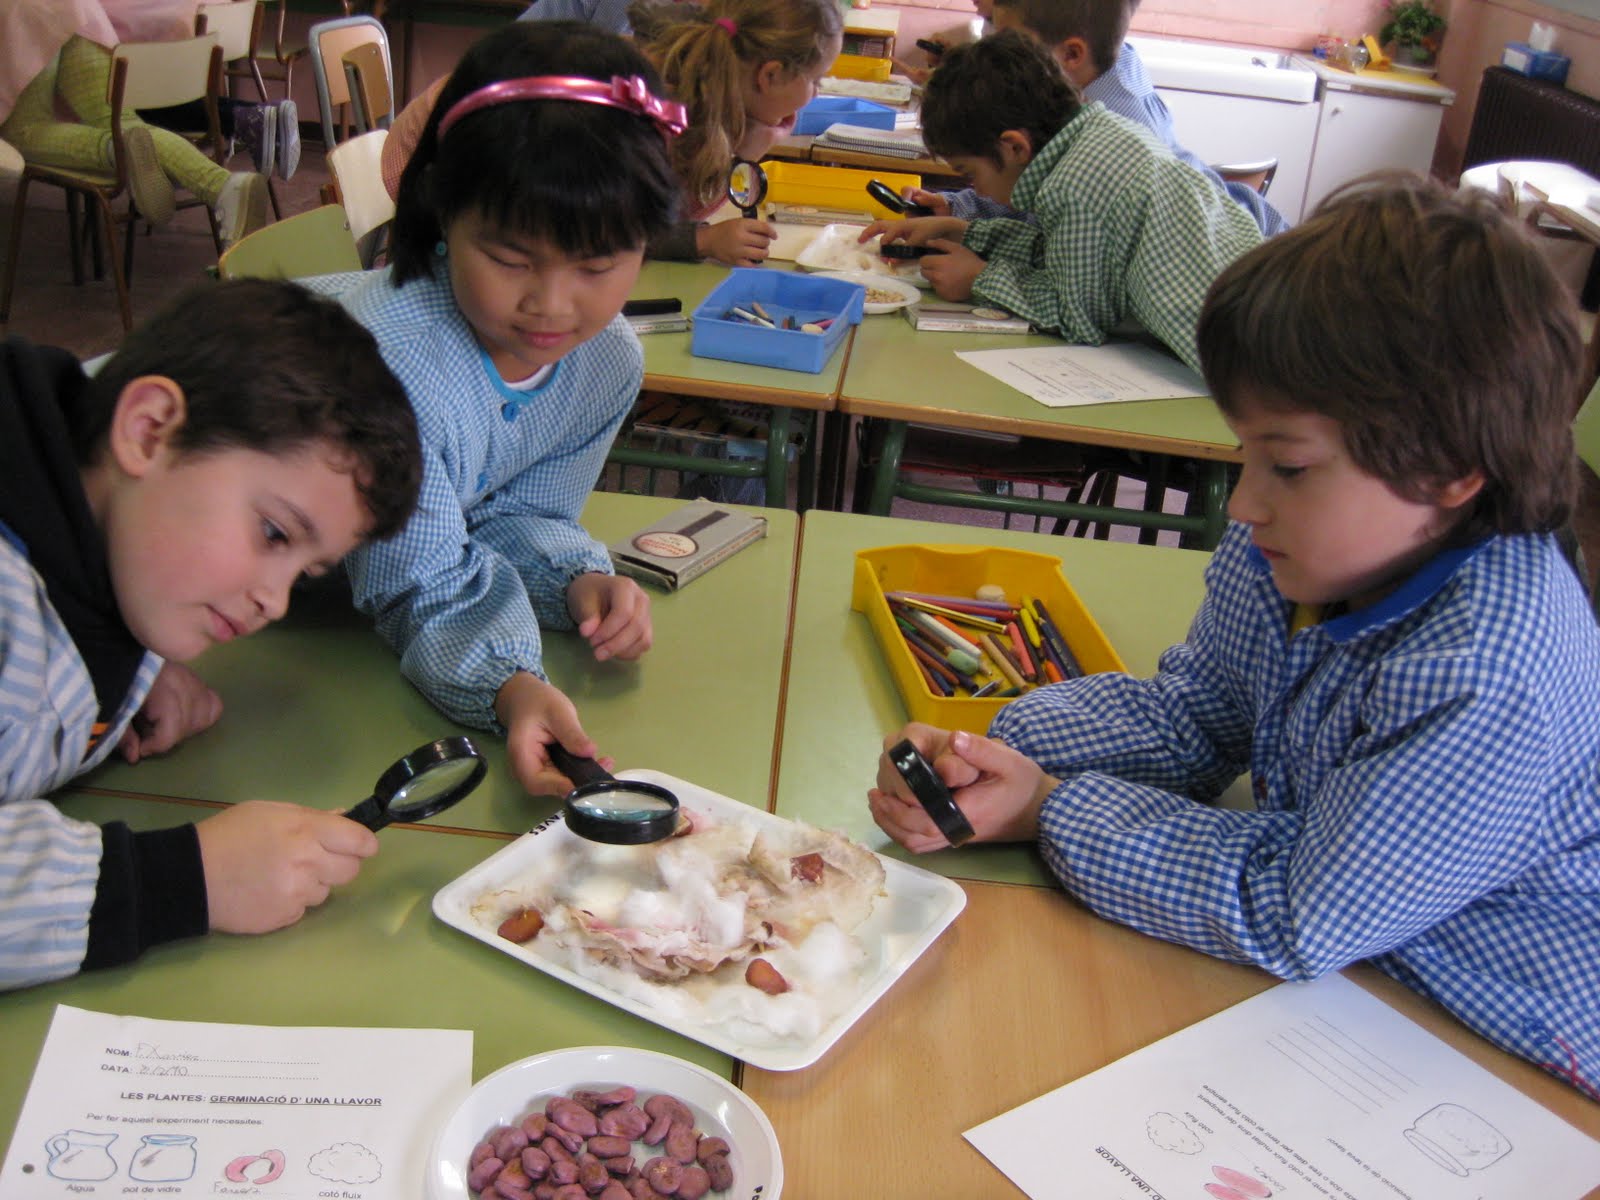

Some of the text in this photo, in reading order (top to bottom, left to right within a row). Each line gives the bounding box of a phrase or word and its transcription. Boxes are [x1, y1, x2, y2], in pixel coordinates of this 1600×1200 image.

[105, 1047, 133, 1057] NOM:
[100, 1063, 133, 1074] DATA:
[120, 1092, 144, 1100] LES
[146, 1093, 206, 1102] PLANTES:
[209, 1094, 287, 1104] GERMINACIÓ
[305, 1097, 330, 1105] UNA
[334, 1098, 382, 1106] LLAVOR
[1202, 1085, 1228, 1104] sempre
[1228, 1103, 1242, 1115] fluix
[86, 1113, 103, 1121] Per
[121, 1116, 154, 1124] aquest
[156, 1117, 209, 1125] experiment
[1184, 1111, 1199, 1123] fluix
[1225, 1115, 1237, 1125] del
[1237, 1124, 1252, 1136] dins
[1264, 1131, 1281, 1144] tenir
[1280, 1143, 1294, 1154] per
[1095, 1146, 1132, 1177] LLAVOR
[1273, 1151, 1289, 1165] fluix
[1293, 1152, 1308, 1165] dies
[1308, 1164, 1323, 1176] tres
[65, 1184, 95, 1193] Aigua
[122, 1186, 139, 1194] pot
[1130, 1176, 1152, 1194] UNA
[1311, 1181, 1329, 1195] amb
[1329, 1180, 1344, 1192] dos
[318, 1190, 340, 1198] cotó
